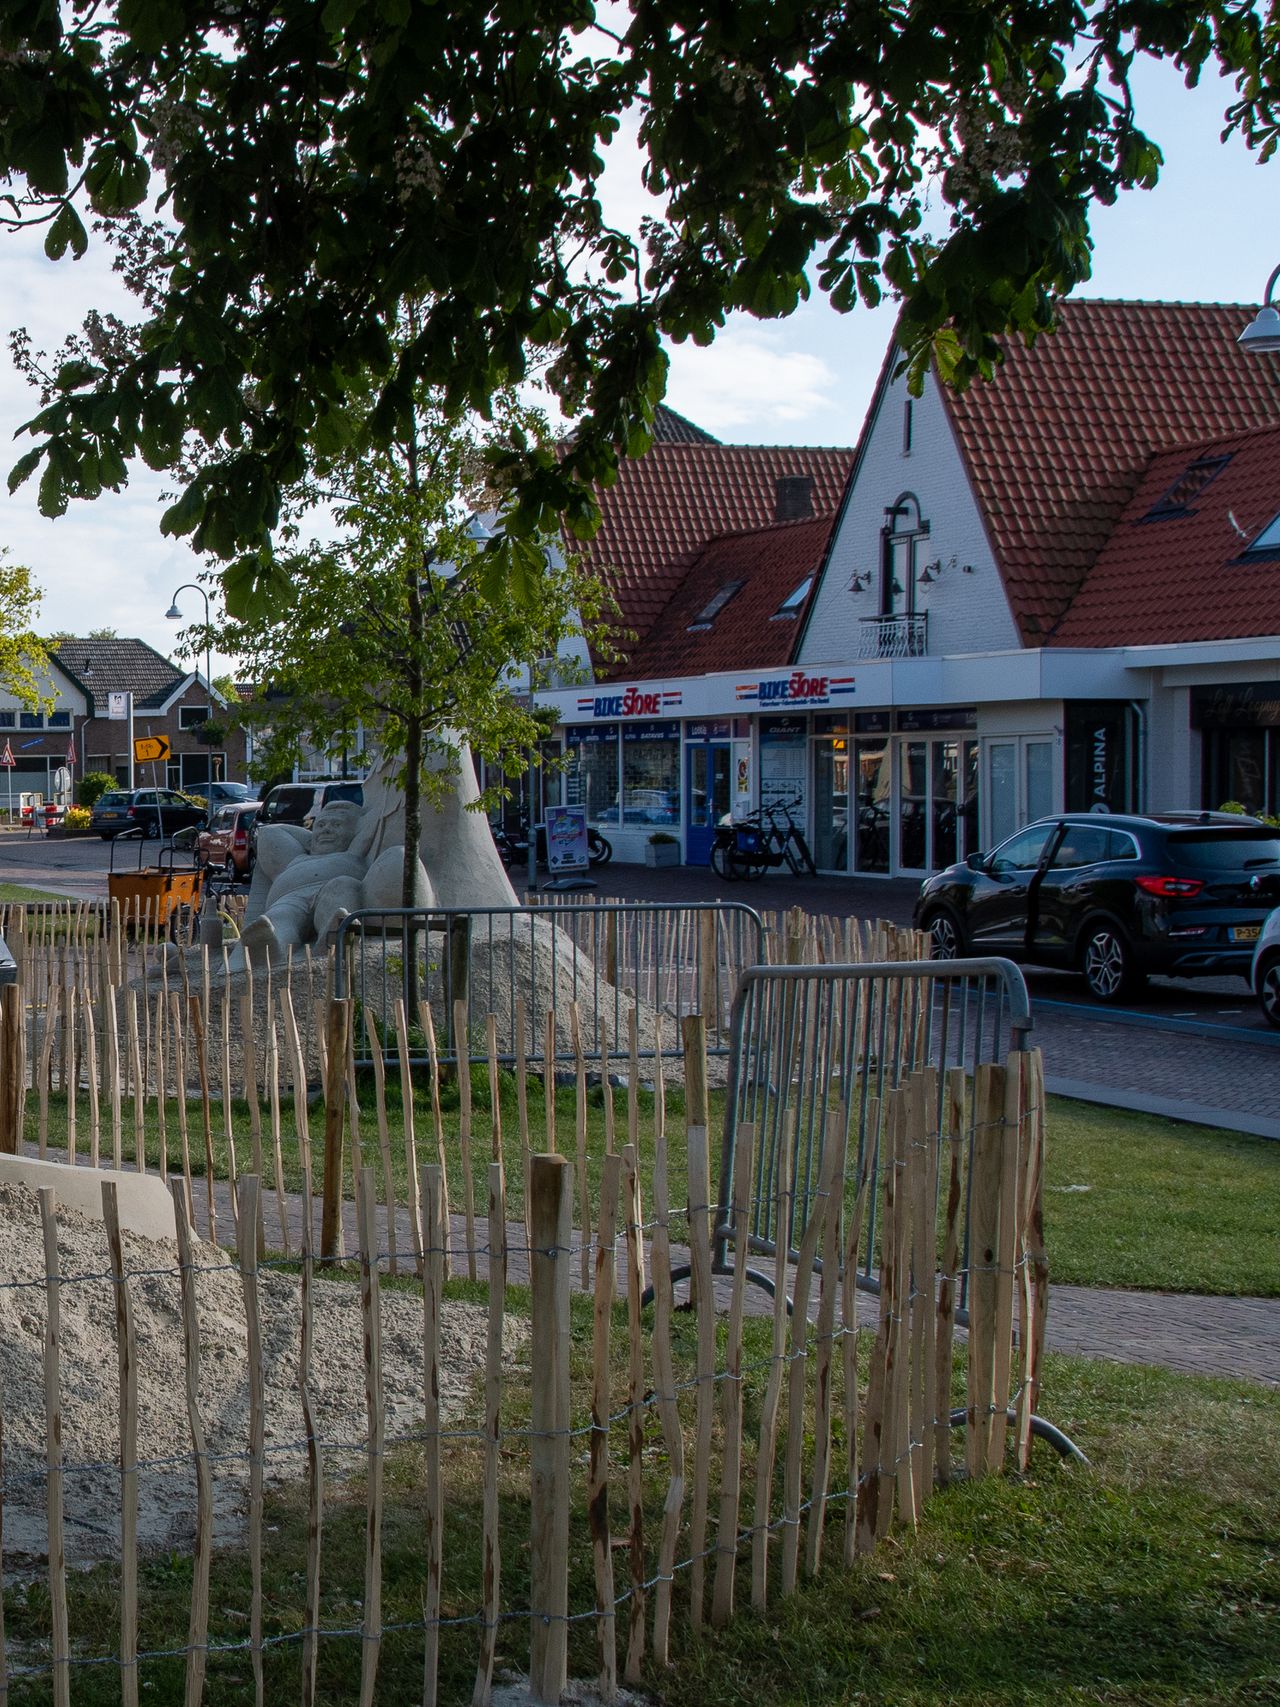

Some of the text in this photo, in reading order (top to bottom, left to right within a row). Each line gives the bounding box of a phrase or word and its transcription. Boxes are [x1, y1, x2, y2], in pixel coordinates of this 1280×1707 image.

[758, 672, 829, 700] BIKESTORE
[593, 687, 662, 717] BIKESTORE
[1093, 727, 1106, 798] ALPINA
